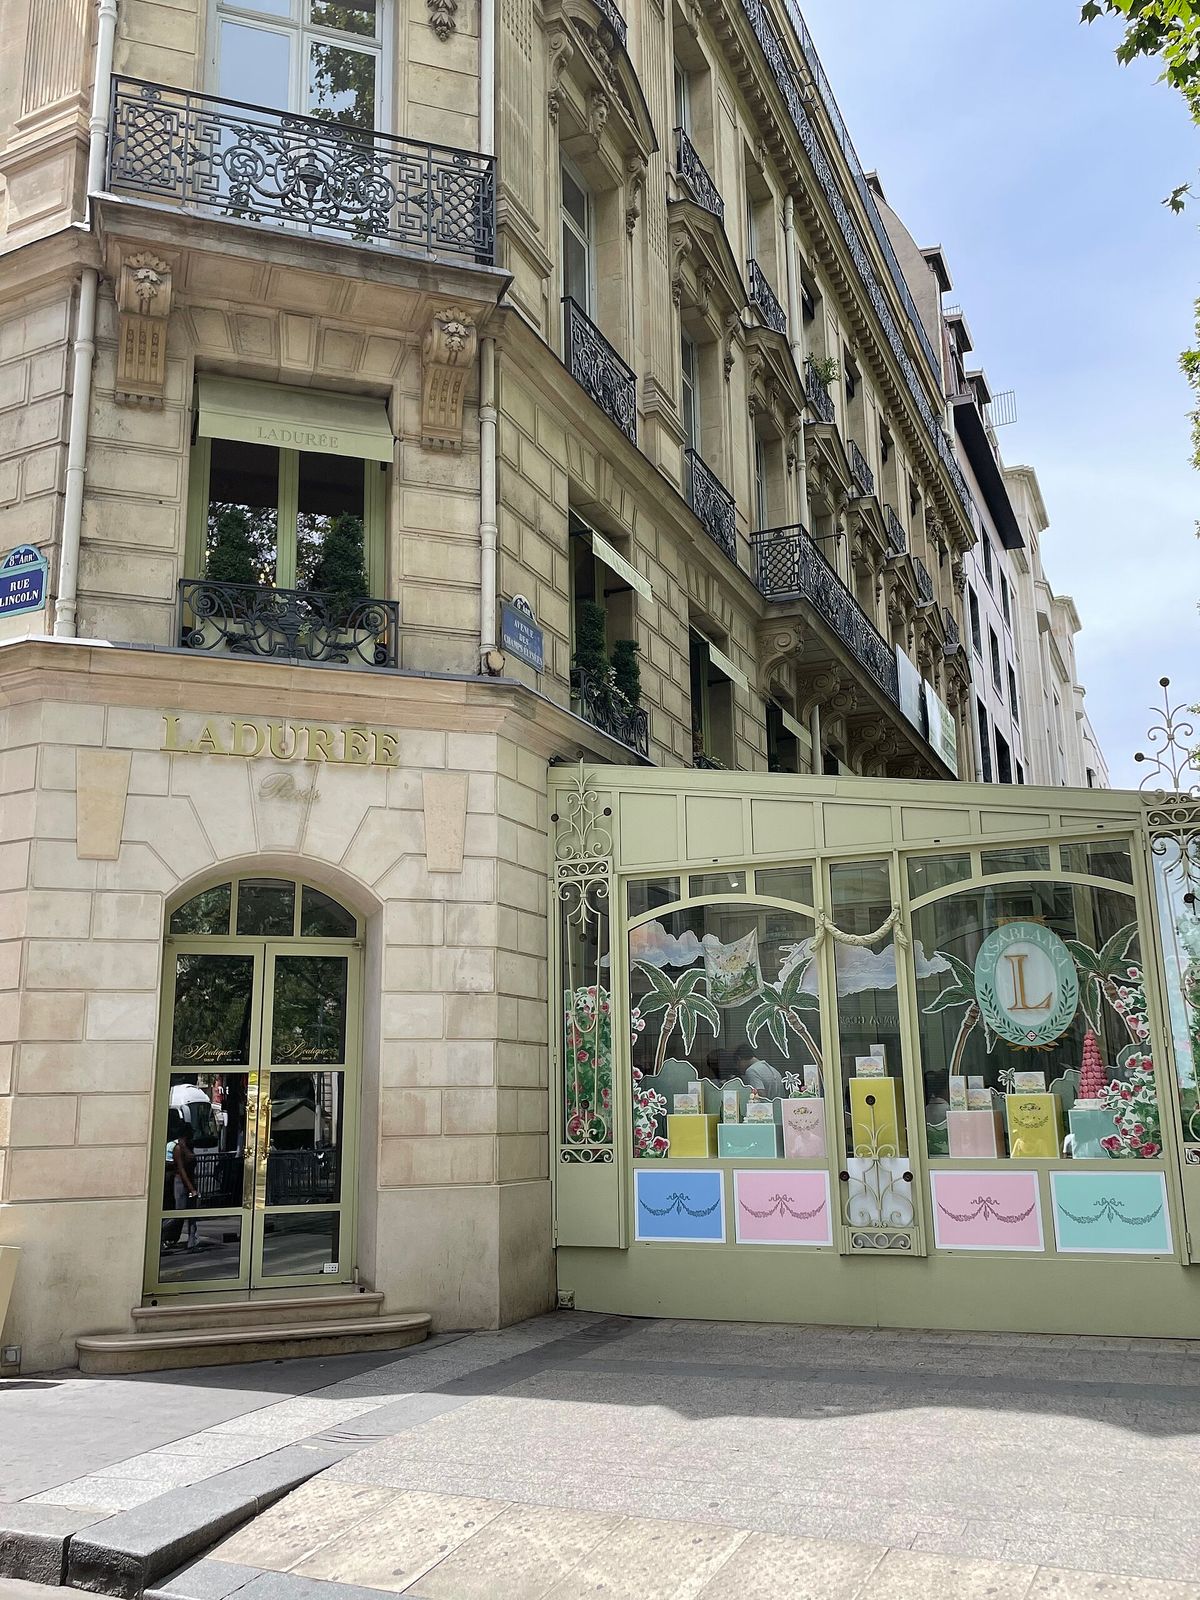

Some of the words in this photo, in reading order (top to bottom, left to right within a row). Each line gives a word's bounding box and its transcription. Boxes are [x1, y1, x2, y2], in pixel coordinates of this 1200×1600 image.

[257, 426, 339, 449] LADURÉE
[10, 578, 30, 591] RUE
[0, 589, 39, 607] LINCOLN
[513, 619, 534, 639] AVENUE
[518, 633, 529, 646] DES
[160, 714, 400, 767] LADURÉE
[979, 926, 1069, 973] CASABLANCA
[1003, 953, 1054, 1012] L
[180, 1040, 242, 1061] Boutique
[278, 1039, 337, 1060] Boutique
